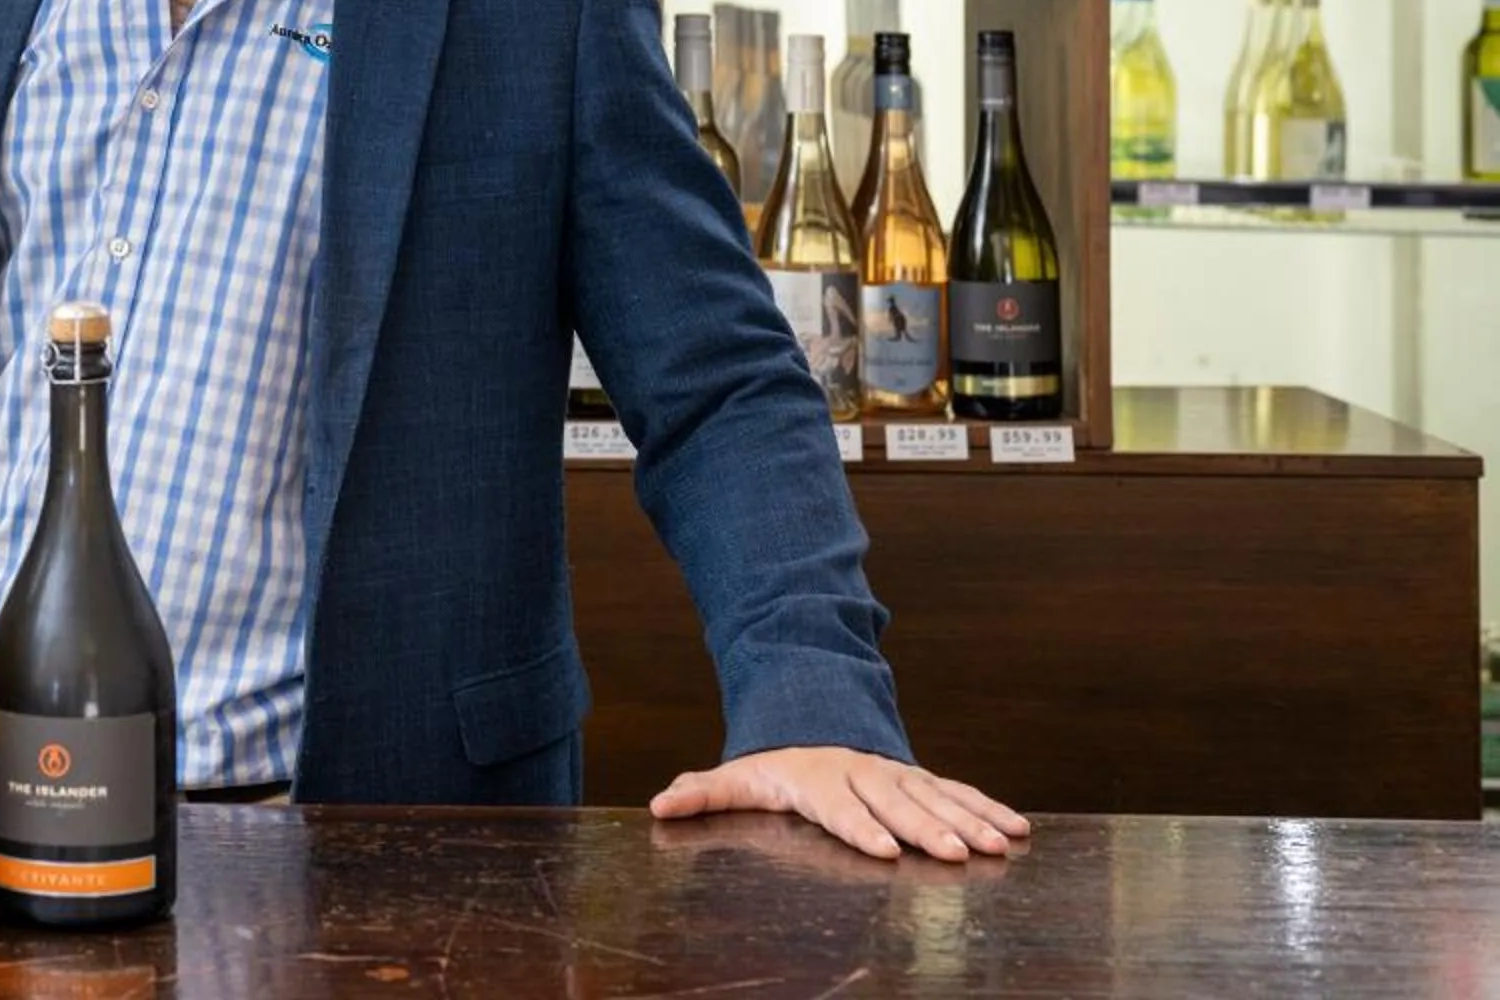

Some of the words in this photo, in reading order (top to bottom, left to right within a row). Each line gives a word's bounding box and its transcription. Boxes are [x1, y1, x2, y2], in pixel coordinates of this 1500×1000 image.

[1002, 430, 1062, 444] $59.99
[7, 781, 32, 795] THE
[35, 784, 108, 798] ISLANDER
